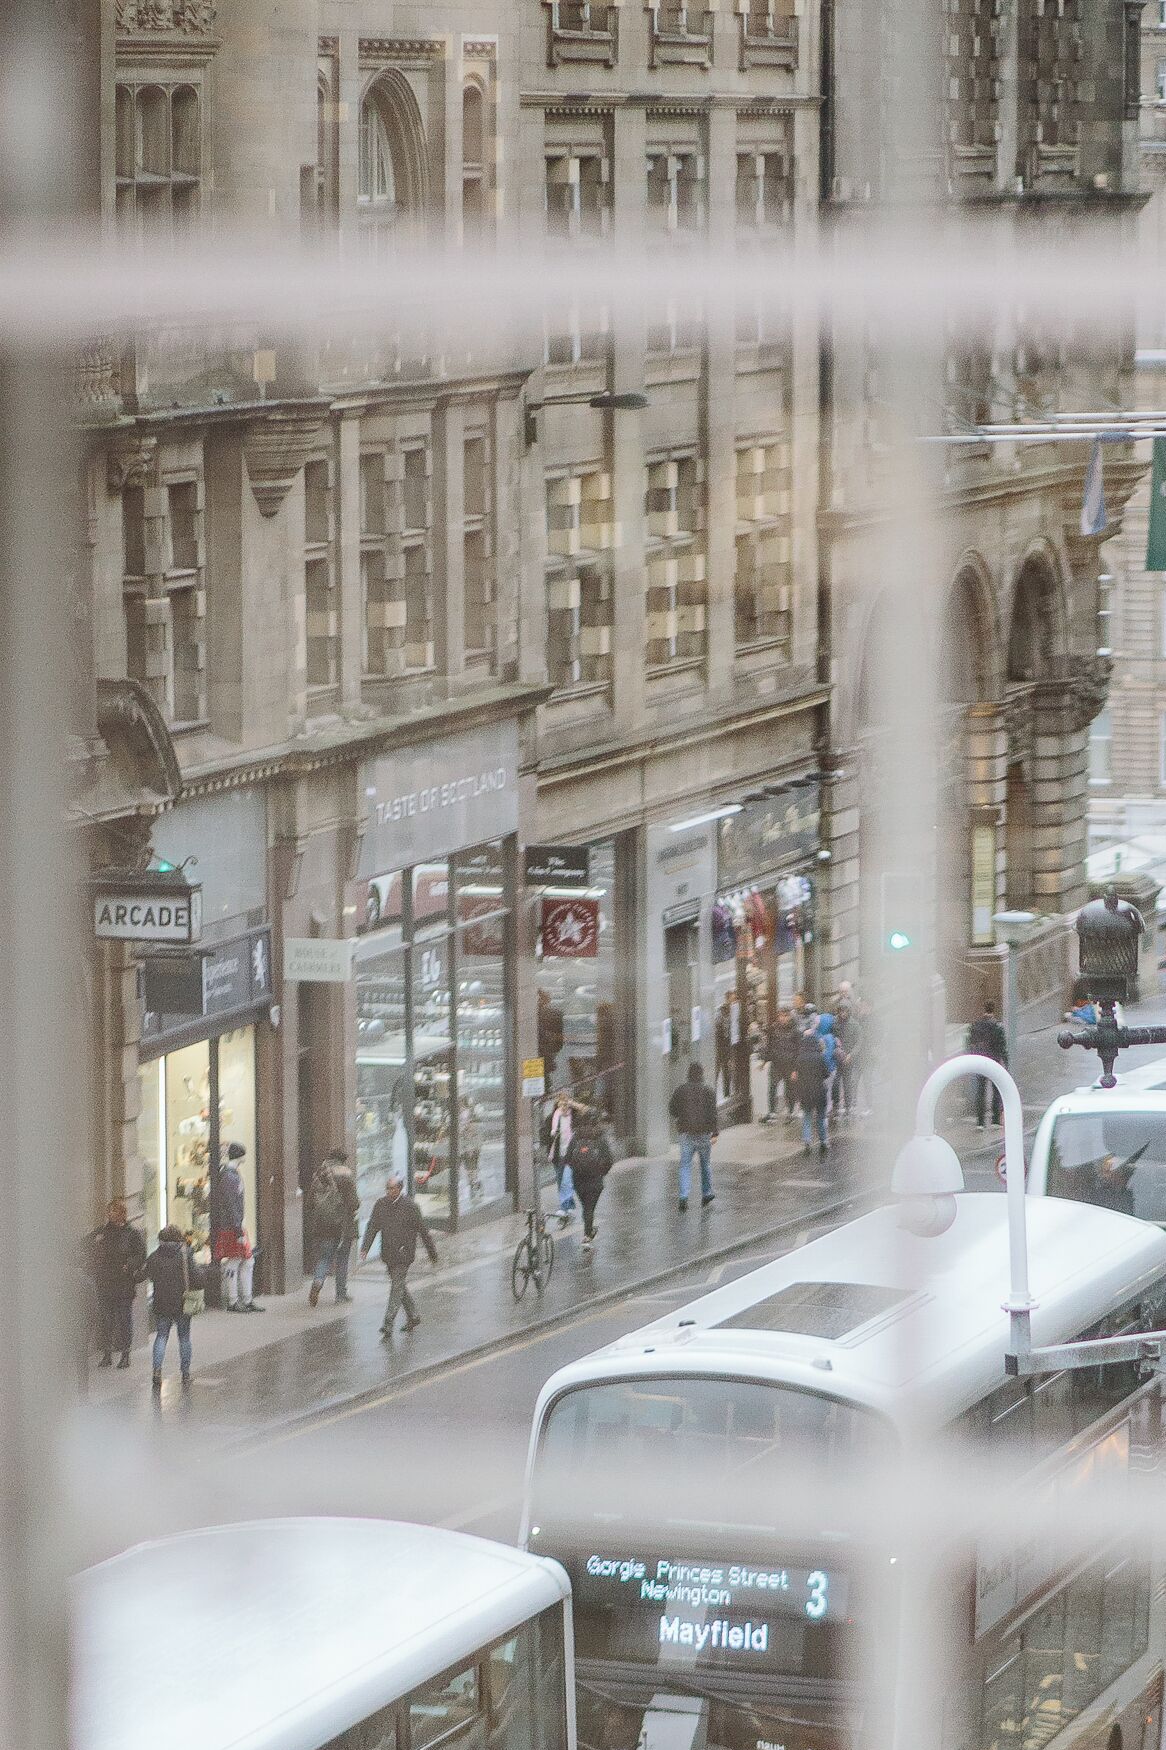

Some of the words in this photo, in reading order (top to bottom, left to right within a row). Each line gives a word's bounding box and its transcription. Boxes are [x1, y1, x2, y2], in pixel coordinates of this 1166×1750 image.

[99, 904, 189, 928] ARCADE
[586, 1554, 647, 1582] Gorgie
[656, 1560, 723, 1584] Princes
[728, 1566, 789, 1591] Street
[640, 1578, 732, 1607] Newington
[805, 1570, 829, 1620] 3
[659, 1614, 769, 1652] Mayfield
